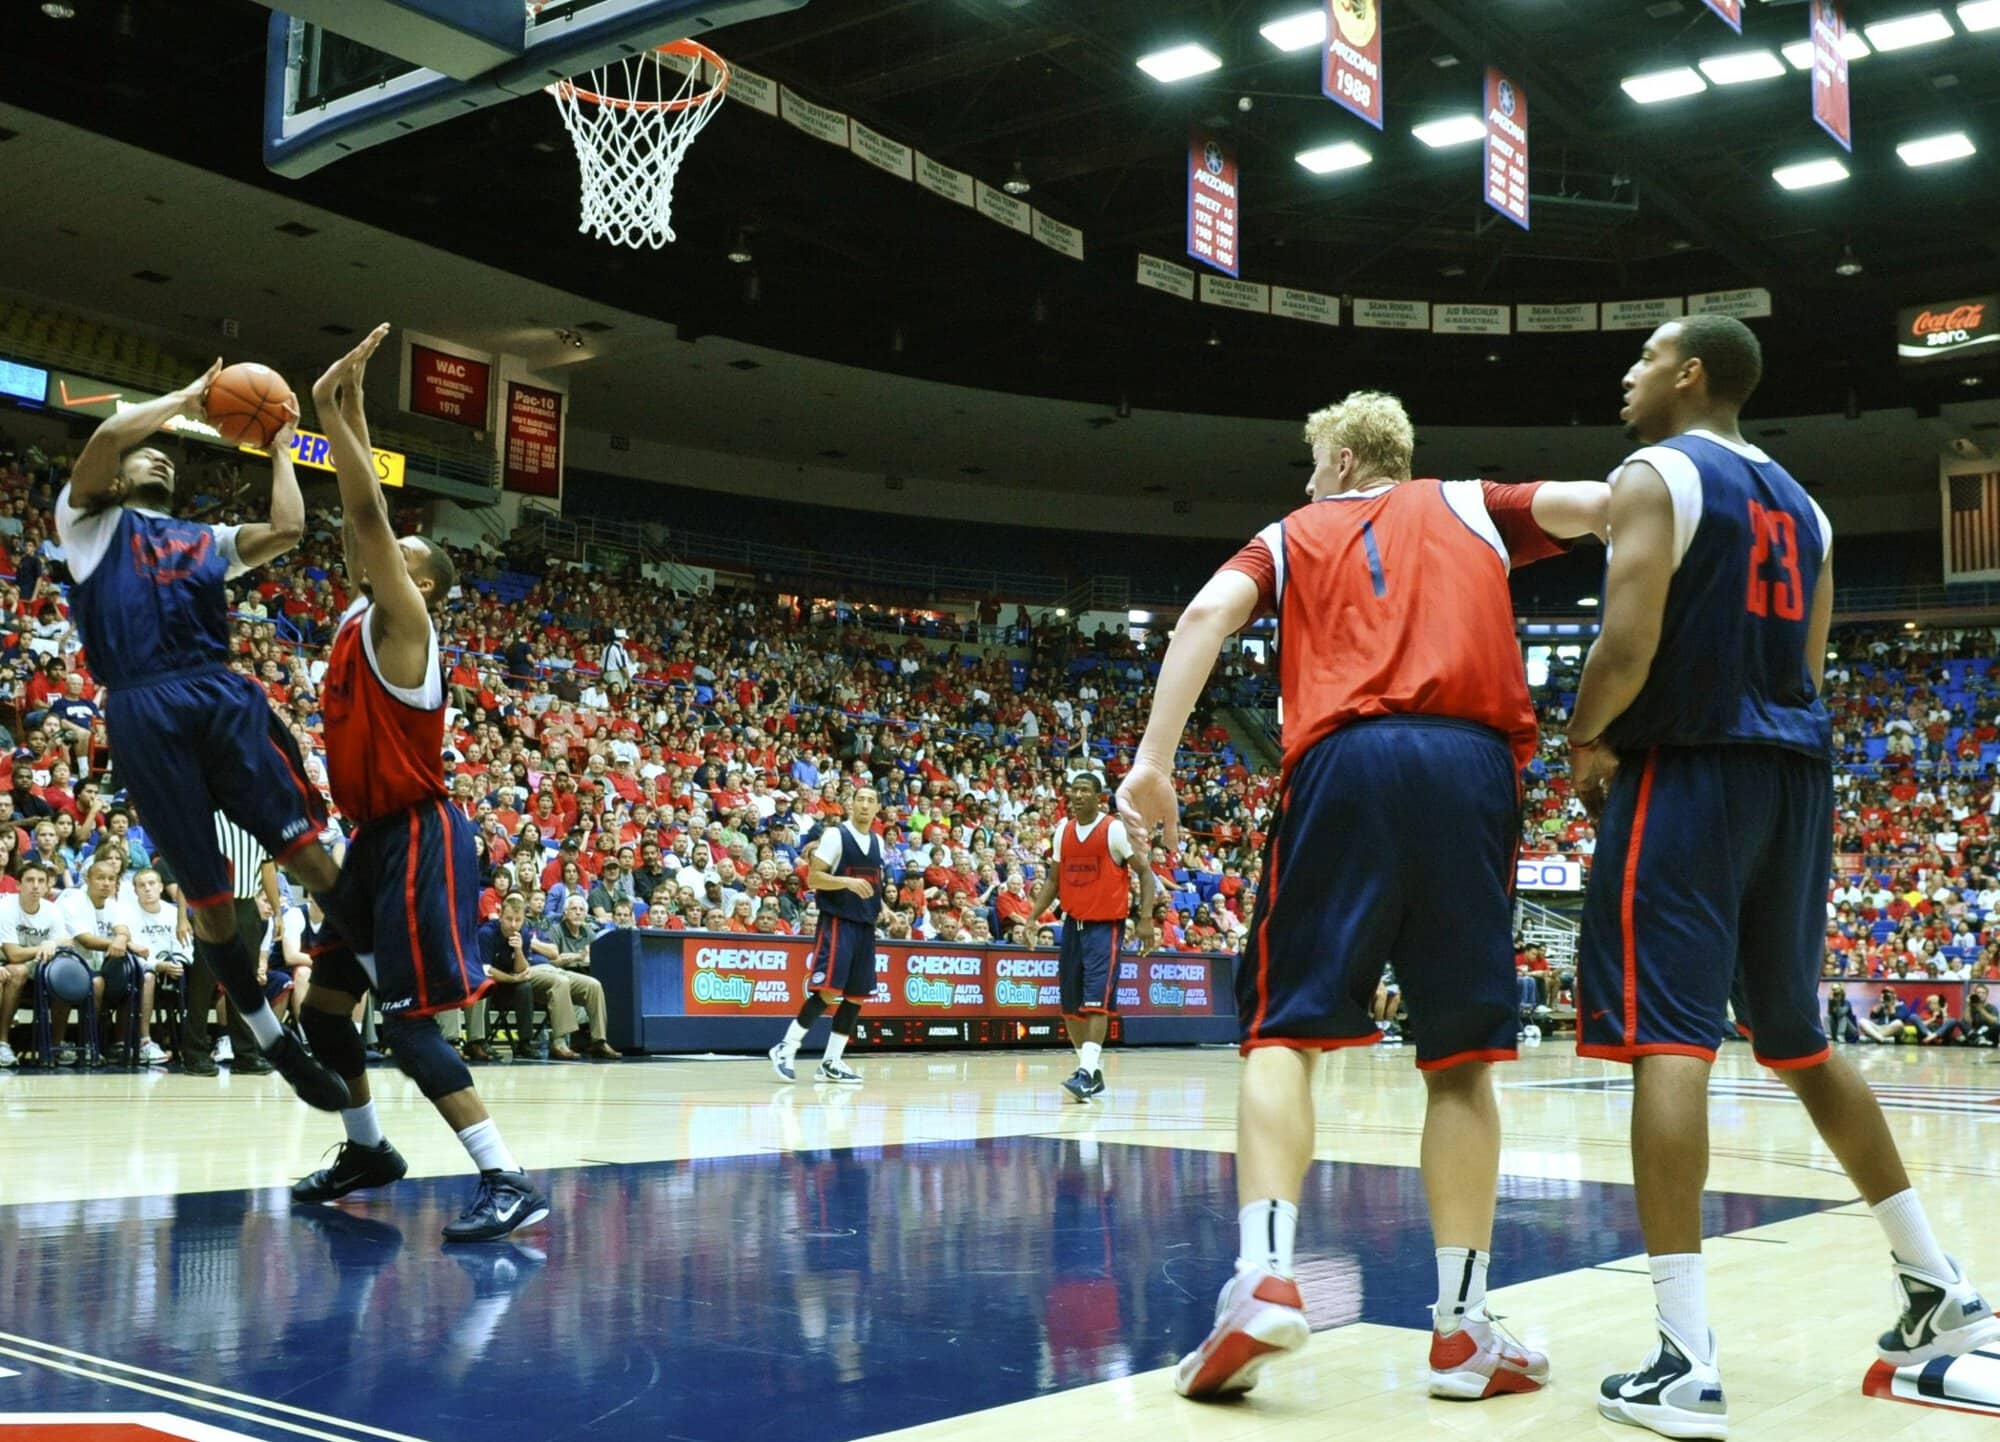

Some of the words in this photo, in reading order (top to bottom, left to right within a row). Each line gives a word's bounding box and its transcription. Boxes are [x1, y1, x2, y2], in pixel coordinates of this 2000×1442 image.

[1329, 39, 1377, 80] ARIZONA
[1337, 69, 1371, 107] 1988
[1194, 168, 1235, 198] ARIZONA
[1194, 192, 1222, 214] SWEET
[1307, 294, 1326, 306] MILLS
[1911, 304, 1985, 337] Coca-Cola
[435, 359, 466, 378] WAC
[515, 390, 554, 410] Pac-10
[1745, 498, 1805, 622] 23
[696, 947, 789, 970] CHECKER
[907, 955, 982, 976] CHECKER
[1150, 963, 1205, 981] CHECKER
[694, 971, 752, 1003] O'Reilly
[755, 980, 786, 991] AUTO
[906, 976, 954, 1006] O'Reilly
[955, 984, 981, 994] AUTO
[996, 979, 1038, 1006] O'Reilly
[1185, 988, 1205, 997] AUTO
[753, 992, 790, 1003] PARTS
[954, 995, 983, 1004] PARTS
[1185, 997, 1208, 1006] PARTS
